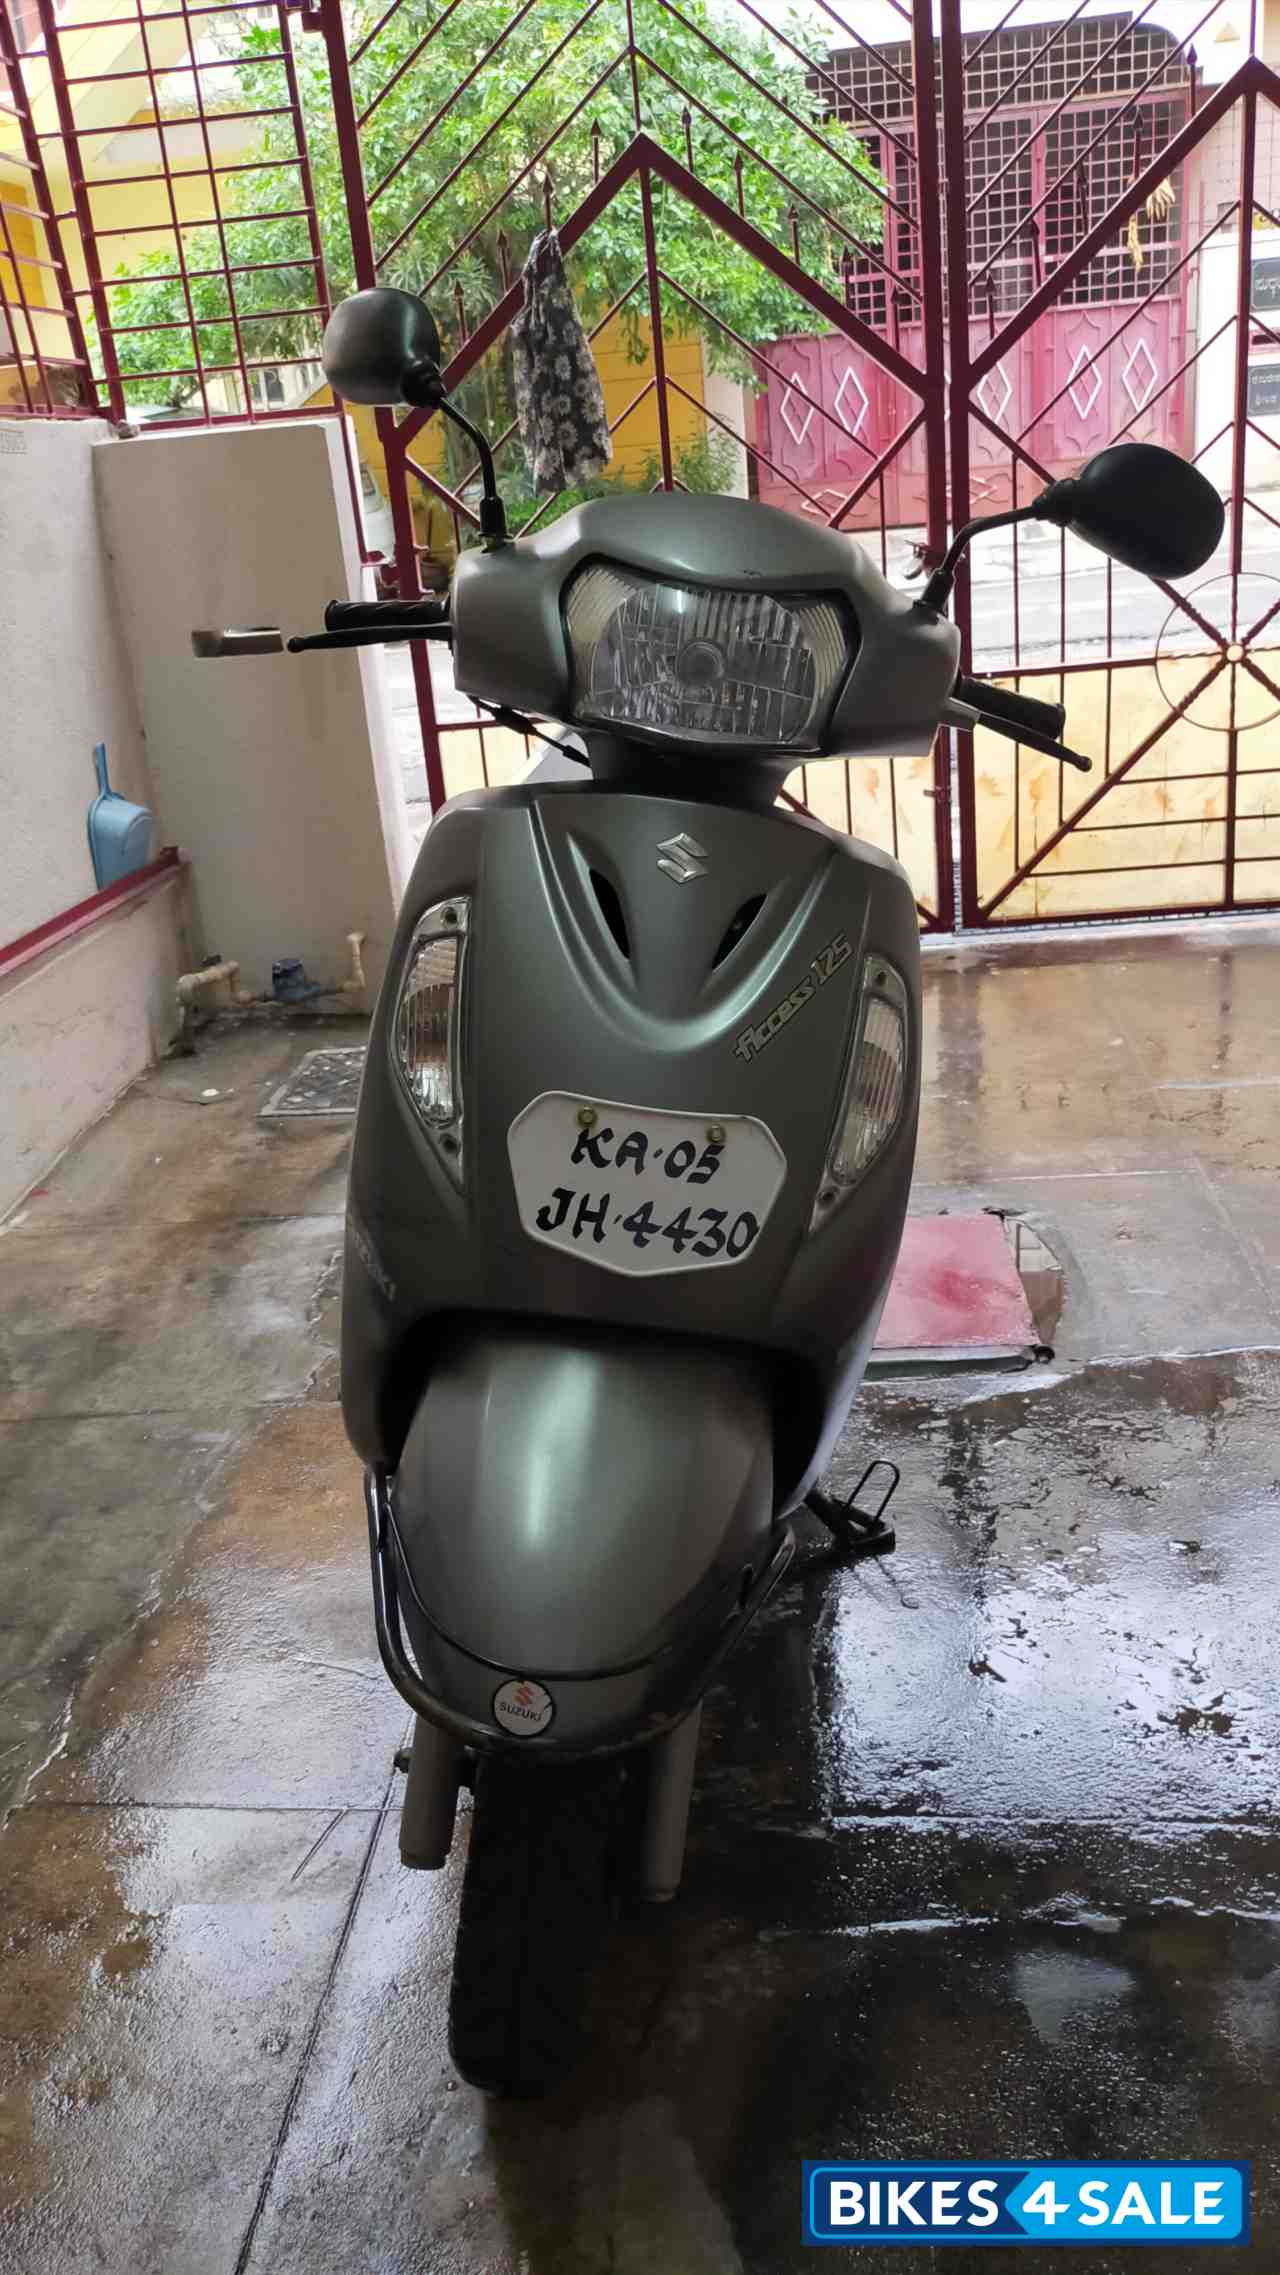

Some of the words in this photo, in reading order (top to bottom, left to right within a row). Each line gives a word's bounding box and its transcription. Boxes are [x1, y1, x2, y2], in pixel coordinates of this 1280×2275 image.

[733, 976, 816, 1062] Access
[811, 933, 853, 985] 125
[500, 1702, 543, 1721] SUZUKI
